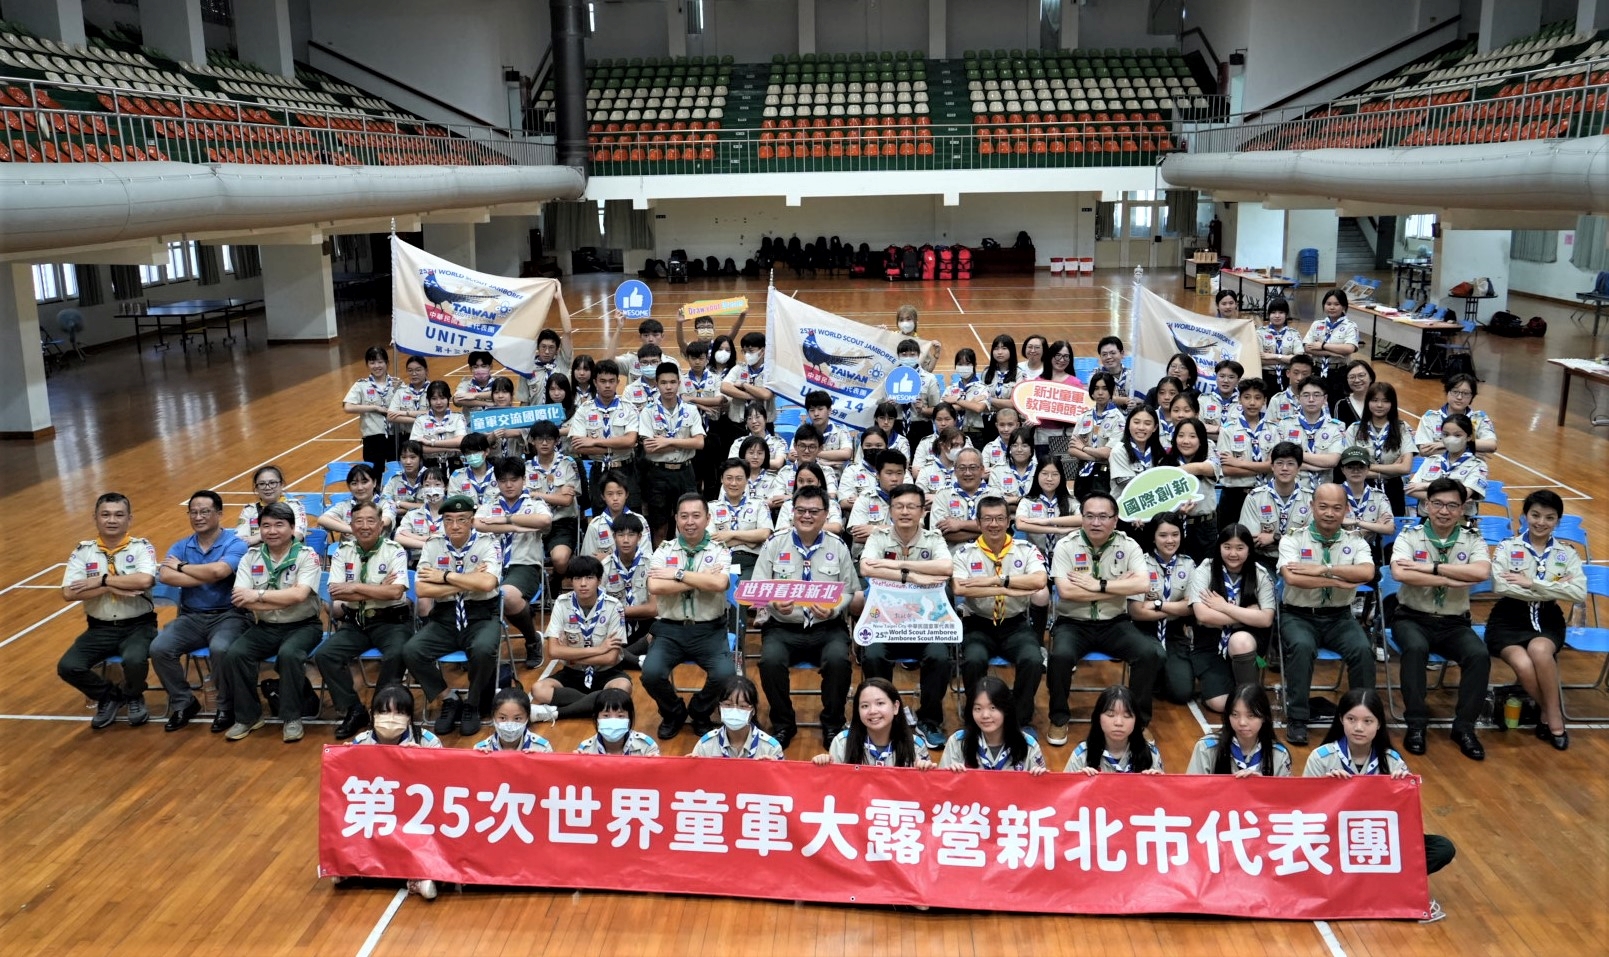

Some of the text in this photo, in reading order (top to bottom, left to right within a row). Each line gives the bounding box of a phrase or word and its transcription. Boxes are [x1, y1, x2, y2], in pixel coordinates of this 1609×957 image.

[439, 269, 464, 278] WORLD
[453, 303, 497, 321] TAIWAN
[1174, 322, 1196, 332] WORLD
[1195, 326, 1212, 336] SCOUT
[426, 326, 494, 351] UNIT 13
[818, 328, 842, 339] WORLD
[843, 335, 864, 346] SCOUT
[864, 343, 898, 365] JAMBOREE
[830, 366, 869, 384] TAIWAN
[1033, 386, 1085, 404] 新北童軍
[844, 400, 865, 414] 14
[473, 406, 560, 430] 童軍交流國際化
[1122, 477, 1190, 517] 國際創新
[341, 775, 1402, 877] 第25次世界童軍大露營新北市代表團
